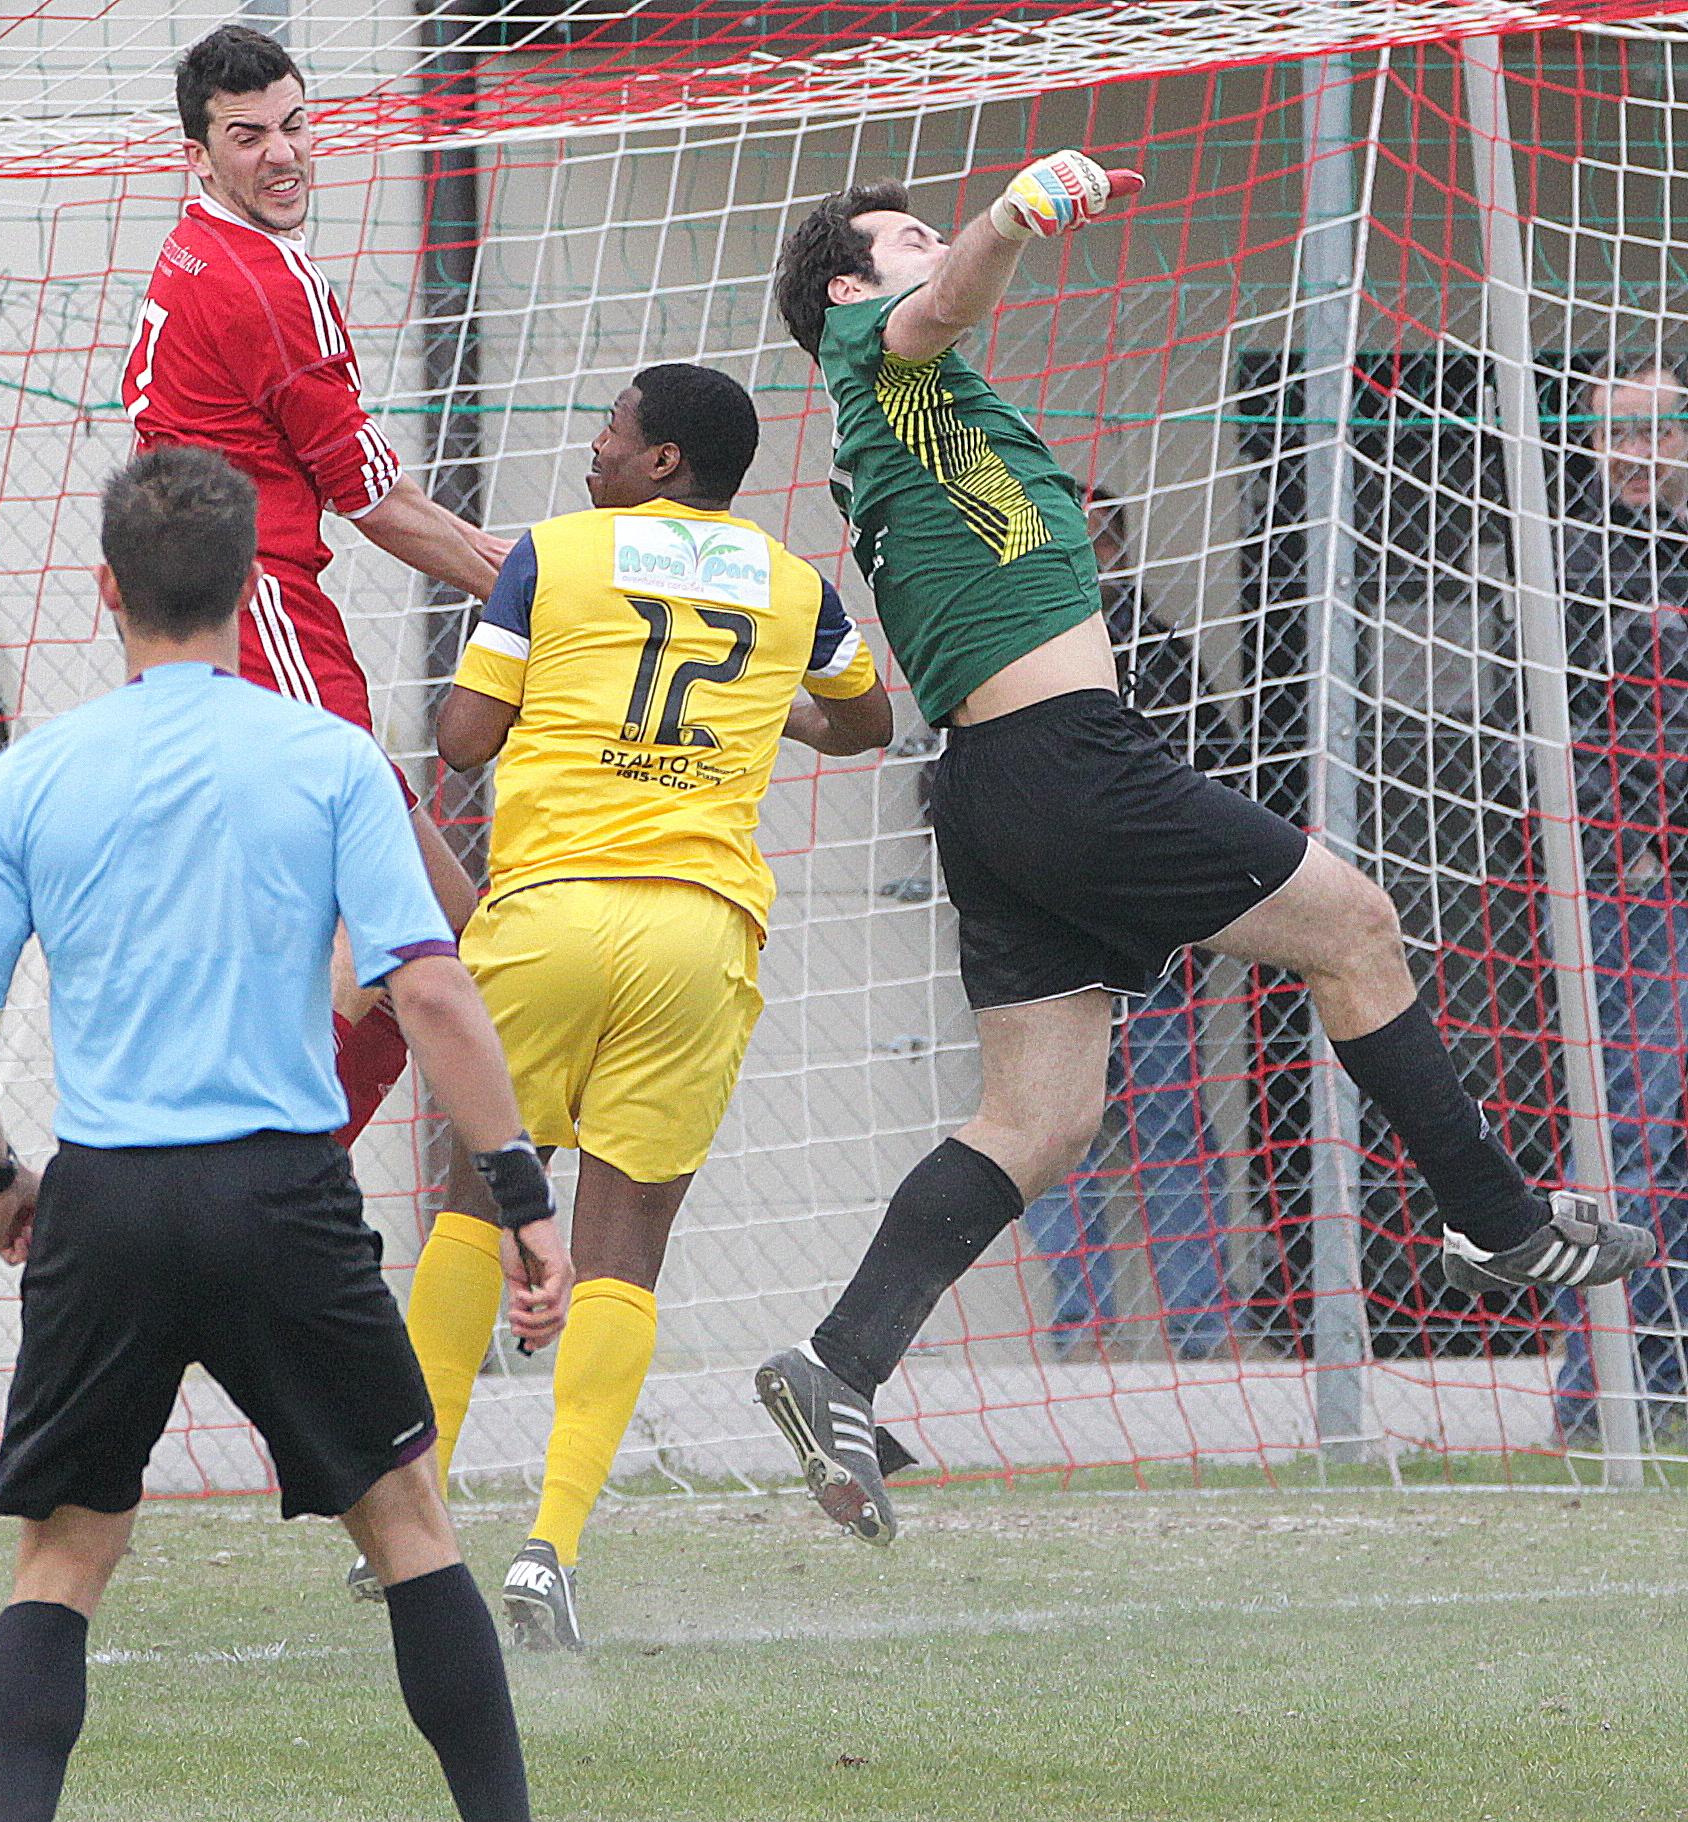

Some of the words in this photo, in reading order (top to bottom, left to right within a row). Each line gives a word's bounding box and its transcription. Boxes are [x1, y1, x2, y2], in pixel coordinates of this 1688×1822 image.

[618, 545, 686, 577] Aqua
[701, 556, 768, 585] Parc
[619, 594, 757, 752] 12
[601, 749, 689, 774] RIALTO
